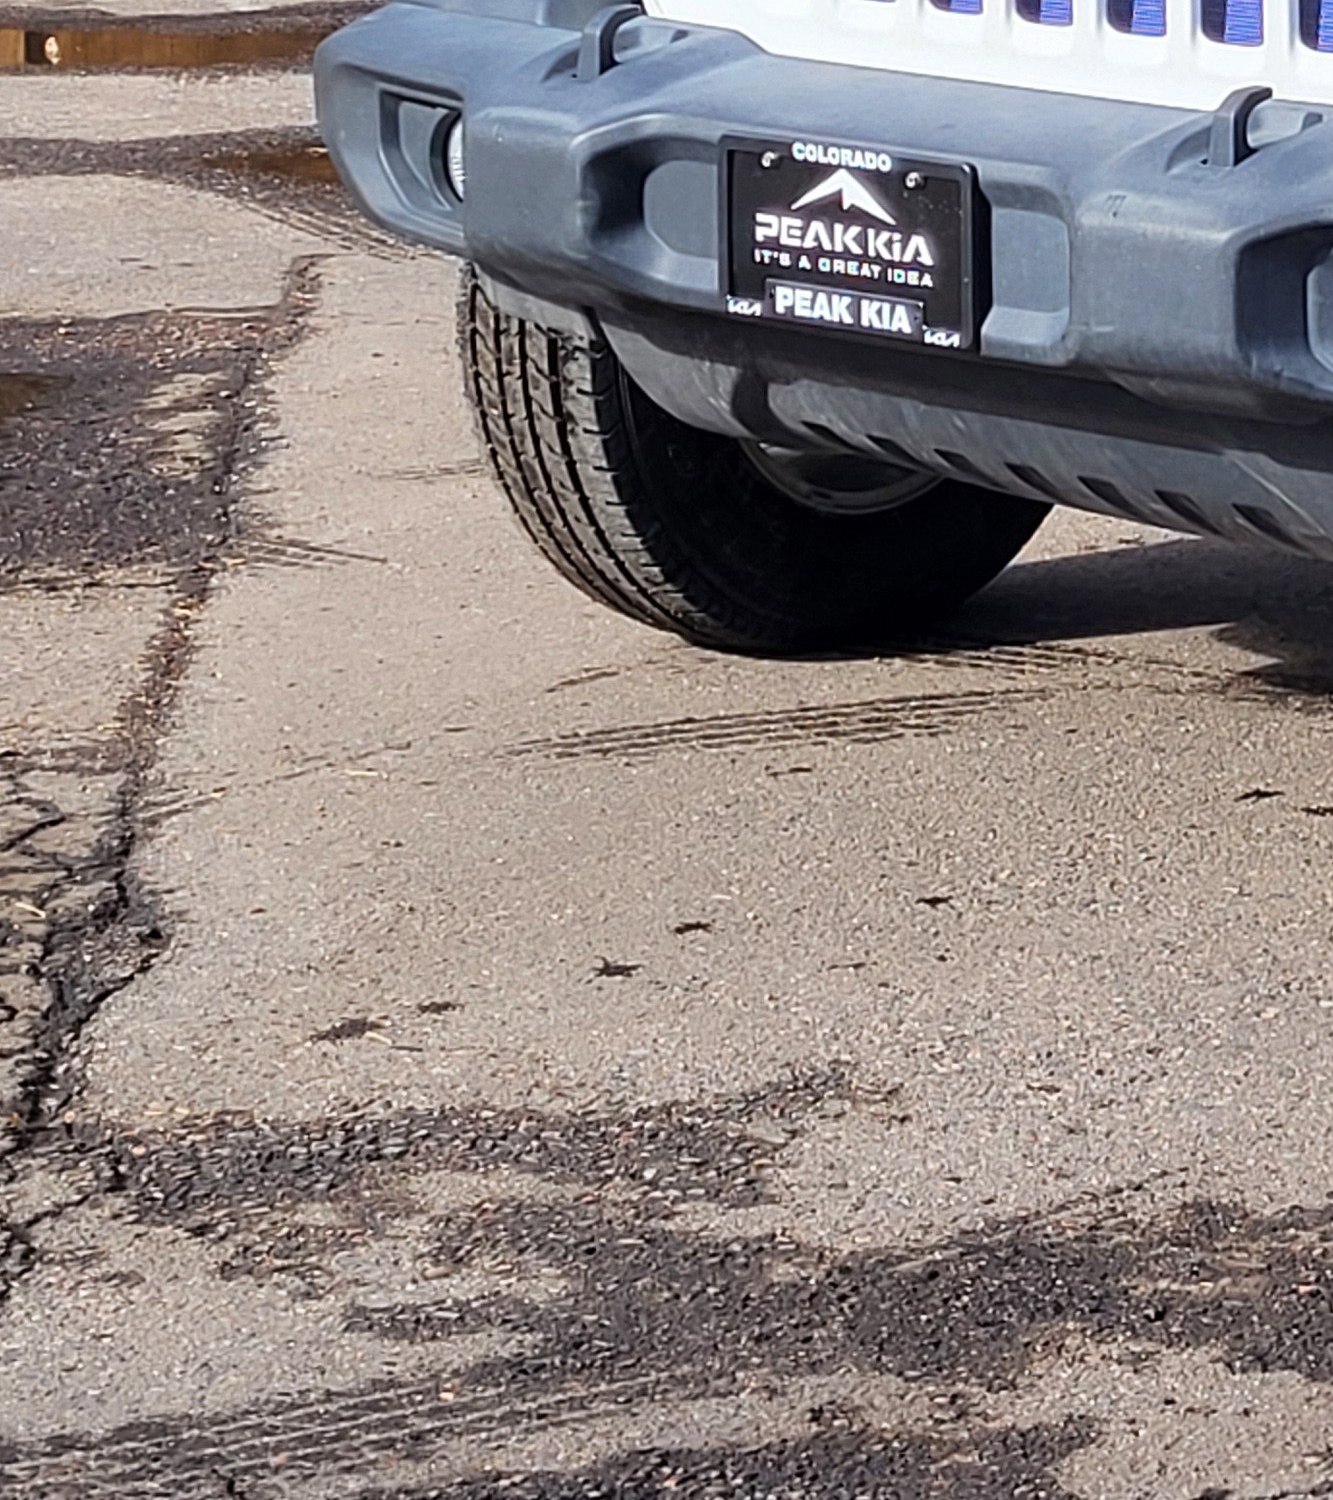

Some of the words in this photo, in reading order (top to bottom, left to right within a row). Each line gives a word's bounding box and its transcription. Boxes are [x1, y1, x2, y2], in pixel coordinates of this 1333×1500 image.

[791, 141, 892, 173] COLORADO
[754, 212, 864, 255] PEAK
[753, 248, 792, 267] IT'S
[798, 254, 812, 271] A
[817, 257, 883, 280] GREAT
[887, 267, 934, 288] IDEA
[774, 285, 854, 325] PEAK
[860, 299, 912, 334] KIA
